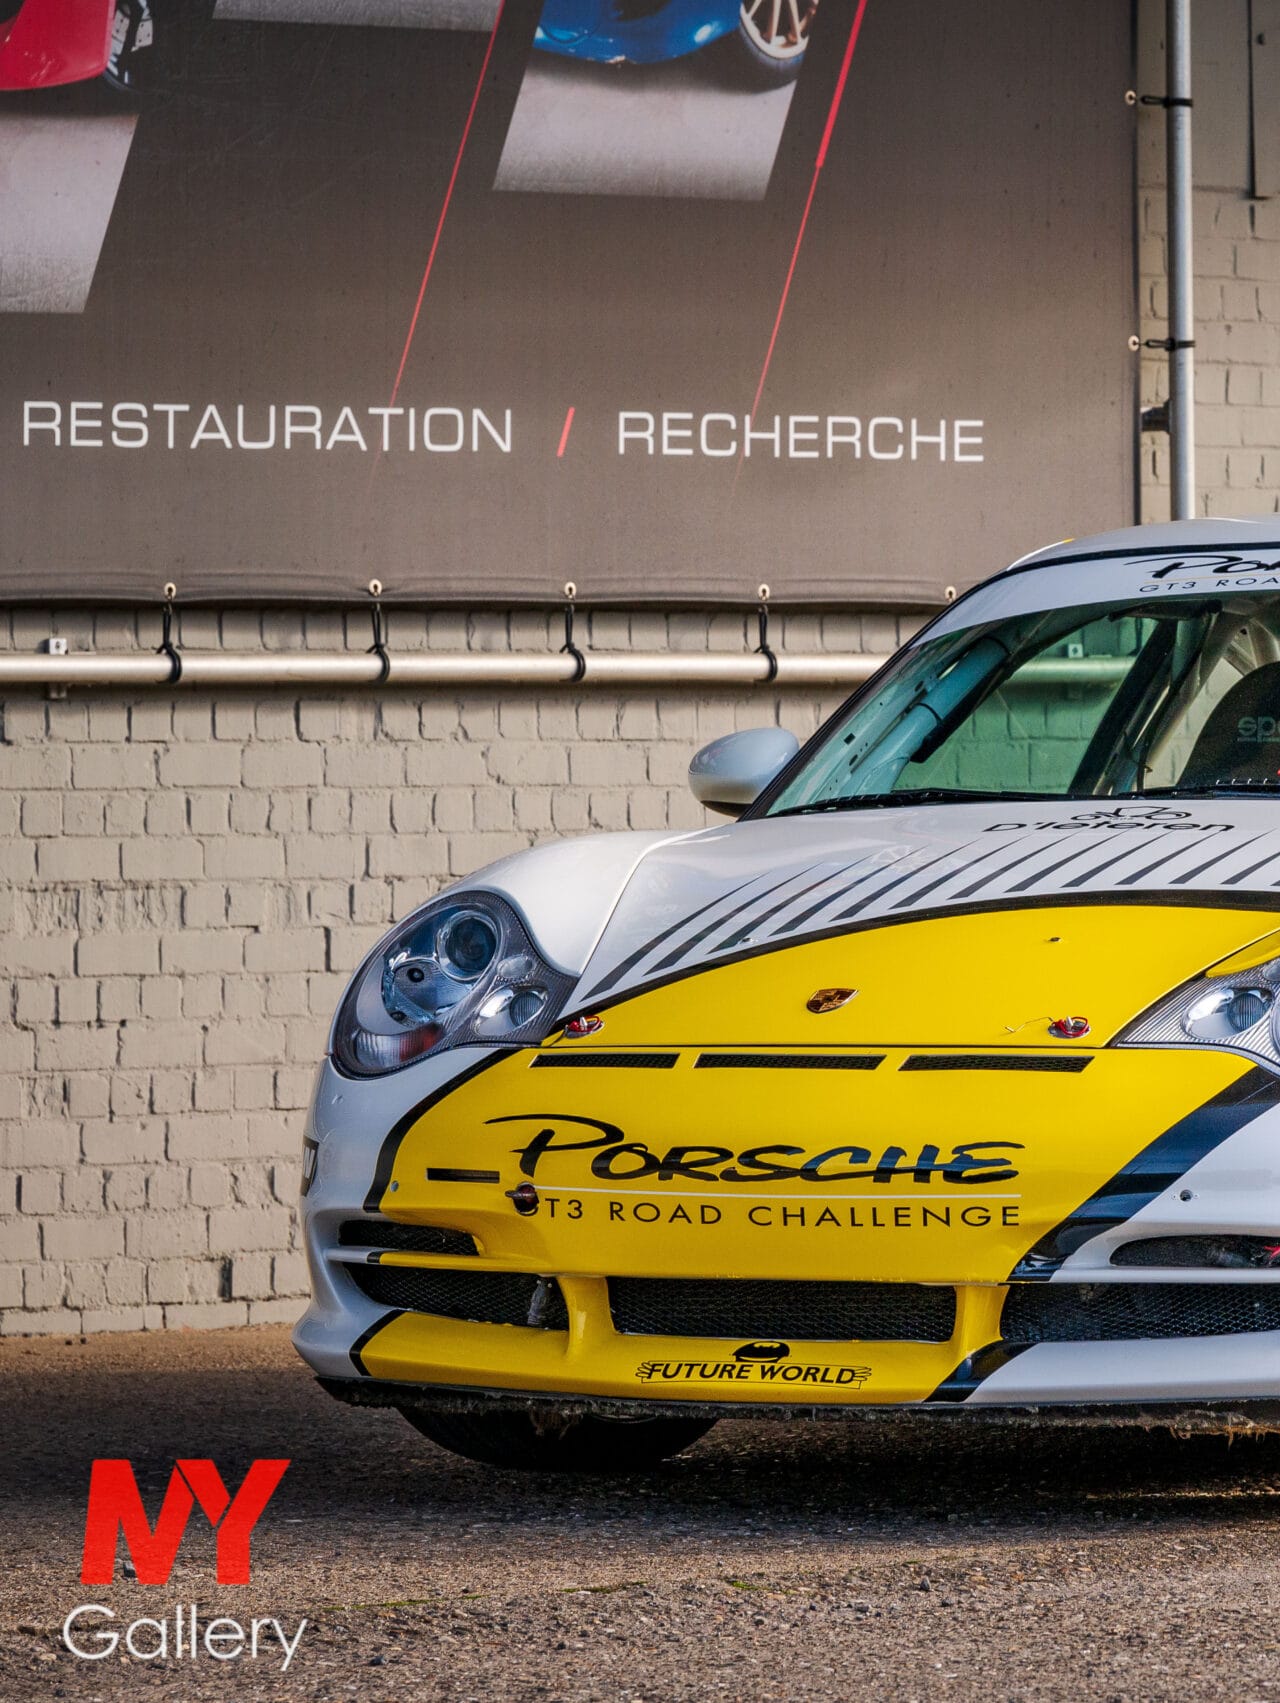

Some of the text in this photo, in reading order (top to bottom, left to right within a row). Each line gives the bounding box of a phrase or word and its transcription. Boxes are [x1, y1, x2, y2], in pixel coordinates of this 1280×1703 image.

[23, 400, 512, 453] RESTAURATION
[618, 411, 985, 463] RECHERCHE
[1139, 580, 1197, 592] GT3
[484, 1113, 1025, 1184] PORSCHE
[609, 1201, 723, 1225] ROAD
[748, 1206, 1021, 1228] CHALLENGE
[648, 1362, 857, 1384] FUTURE WORLD
